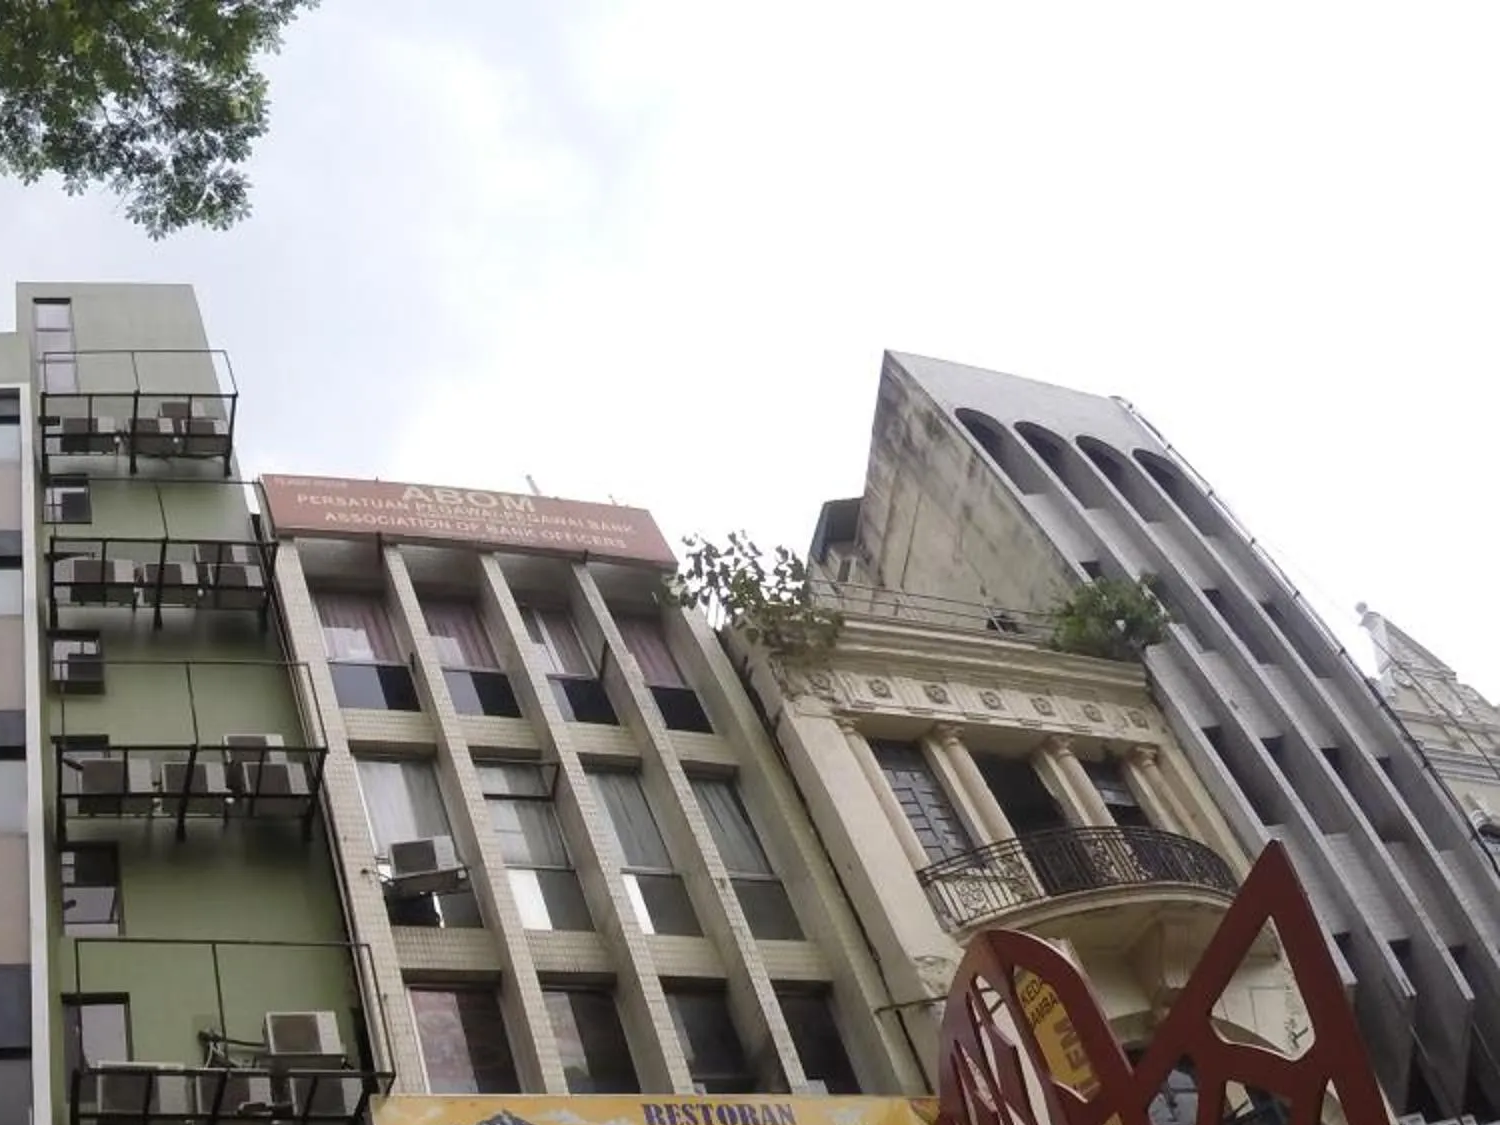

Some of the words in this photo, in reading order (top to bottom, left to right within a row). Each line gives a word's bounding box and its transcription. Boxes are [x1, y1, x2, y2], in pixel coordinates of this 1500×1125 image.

[297, 494, 412, 512] PERSATUAN
[586, 520, 636, 535] BANK
[402, 486, 536, 513] ABOM
[325, 512, 451, 530] ASSOCIATION
[454, 520, 478, 532] OF
[485, 523, 534, 539] BANK
[537, 528, 628, 549] OFFICERS
